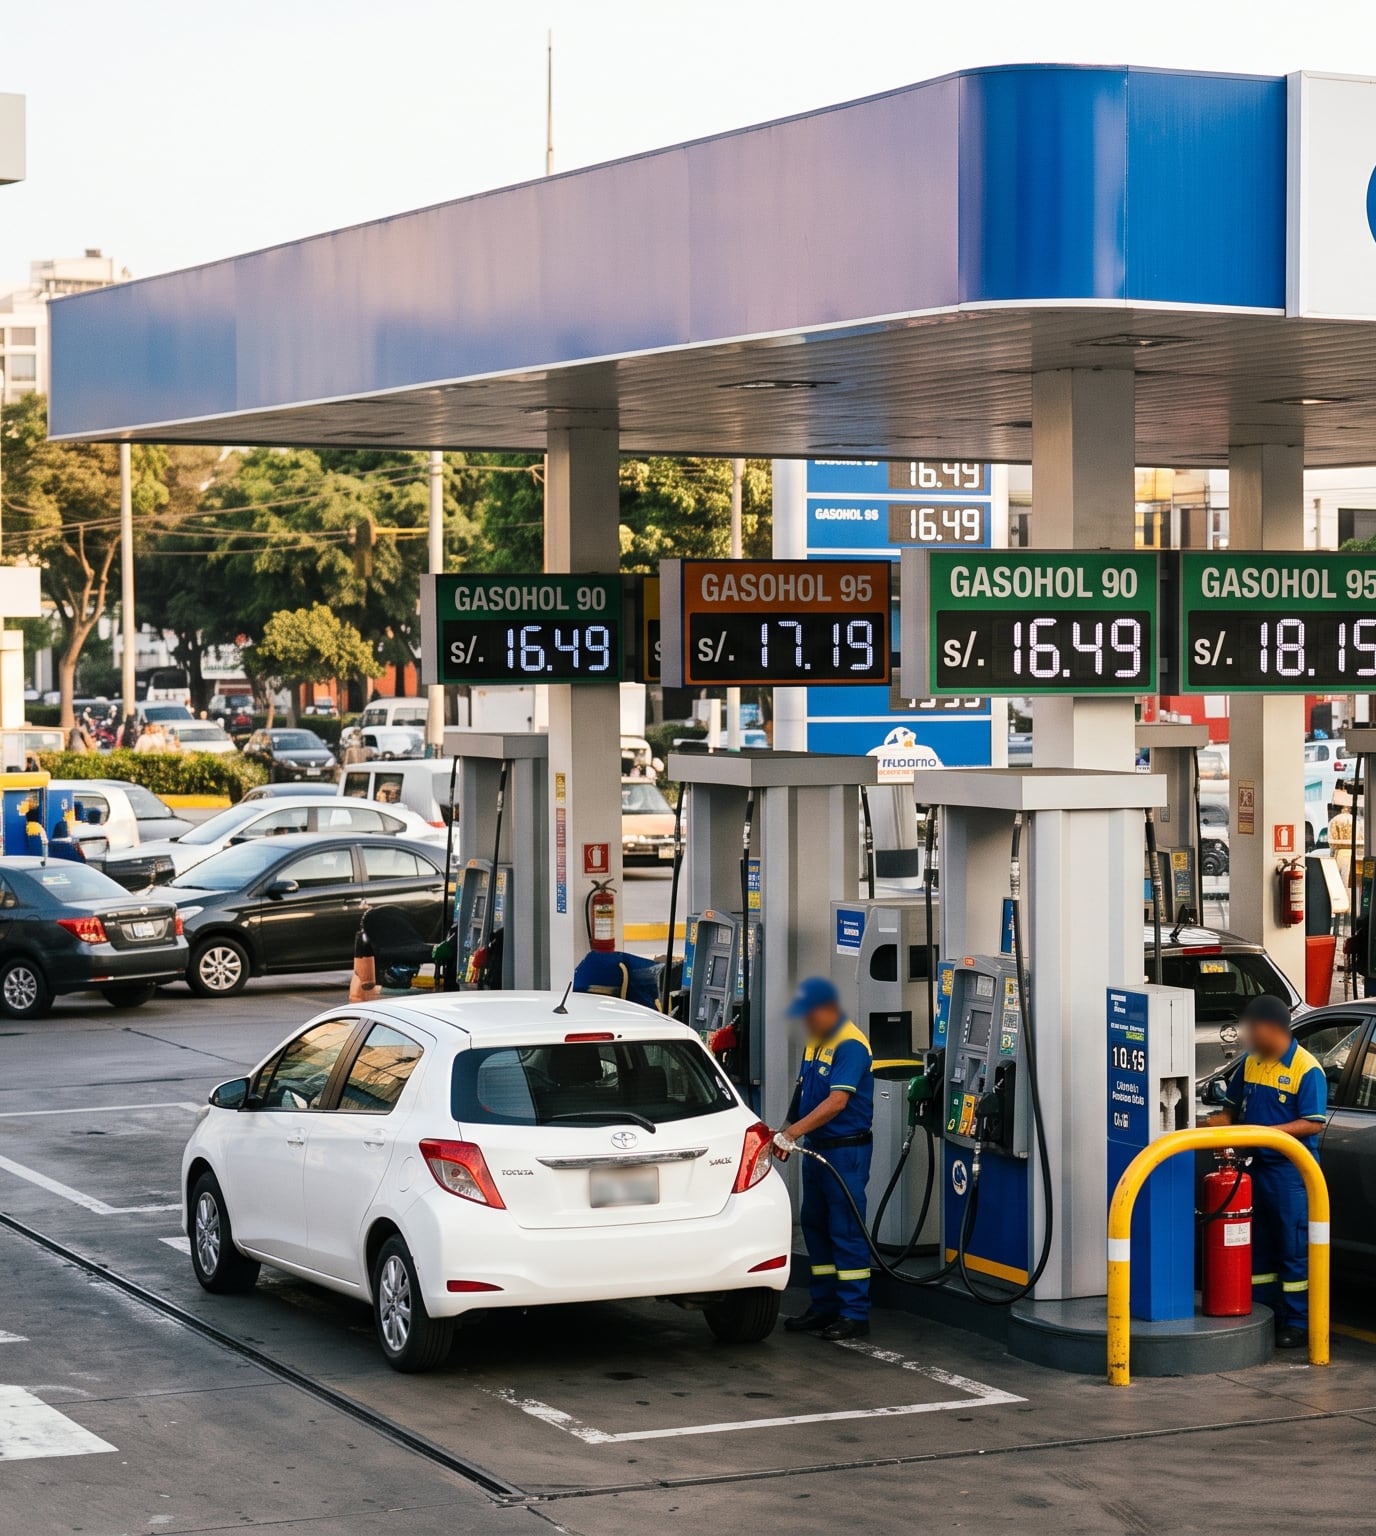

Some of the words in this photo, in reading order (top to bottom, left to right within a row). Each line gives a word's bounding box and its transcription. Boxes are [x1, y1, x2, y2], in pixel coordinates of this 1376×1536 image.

[814, 507, 863, 521] GASOHOL
[910, 508, 980, 541] 16.49
[701, 573, 832, 602] GASOHOL
[839, 574, 873, 602] 95
[950, 565, 1093, 599] GASOHOL
[1101, 566, 1138, 599] 90
[1201, 567, 1337, 599] GASOHOL
[454, 586, 570, 612] GASOHOL
[576, 586, 606, 611] 90
[507, 625, 610, 672] 16.49
[761, 620, 873, 671] 17.19
[1013, 618, 1141, 678] 16.49
